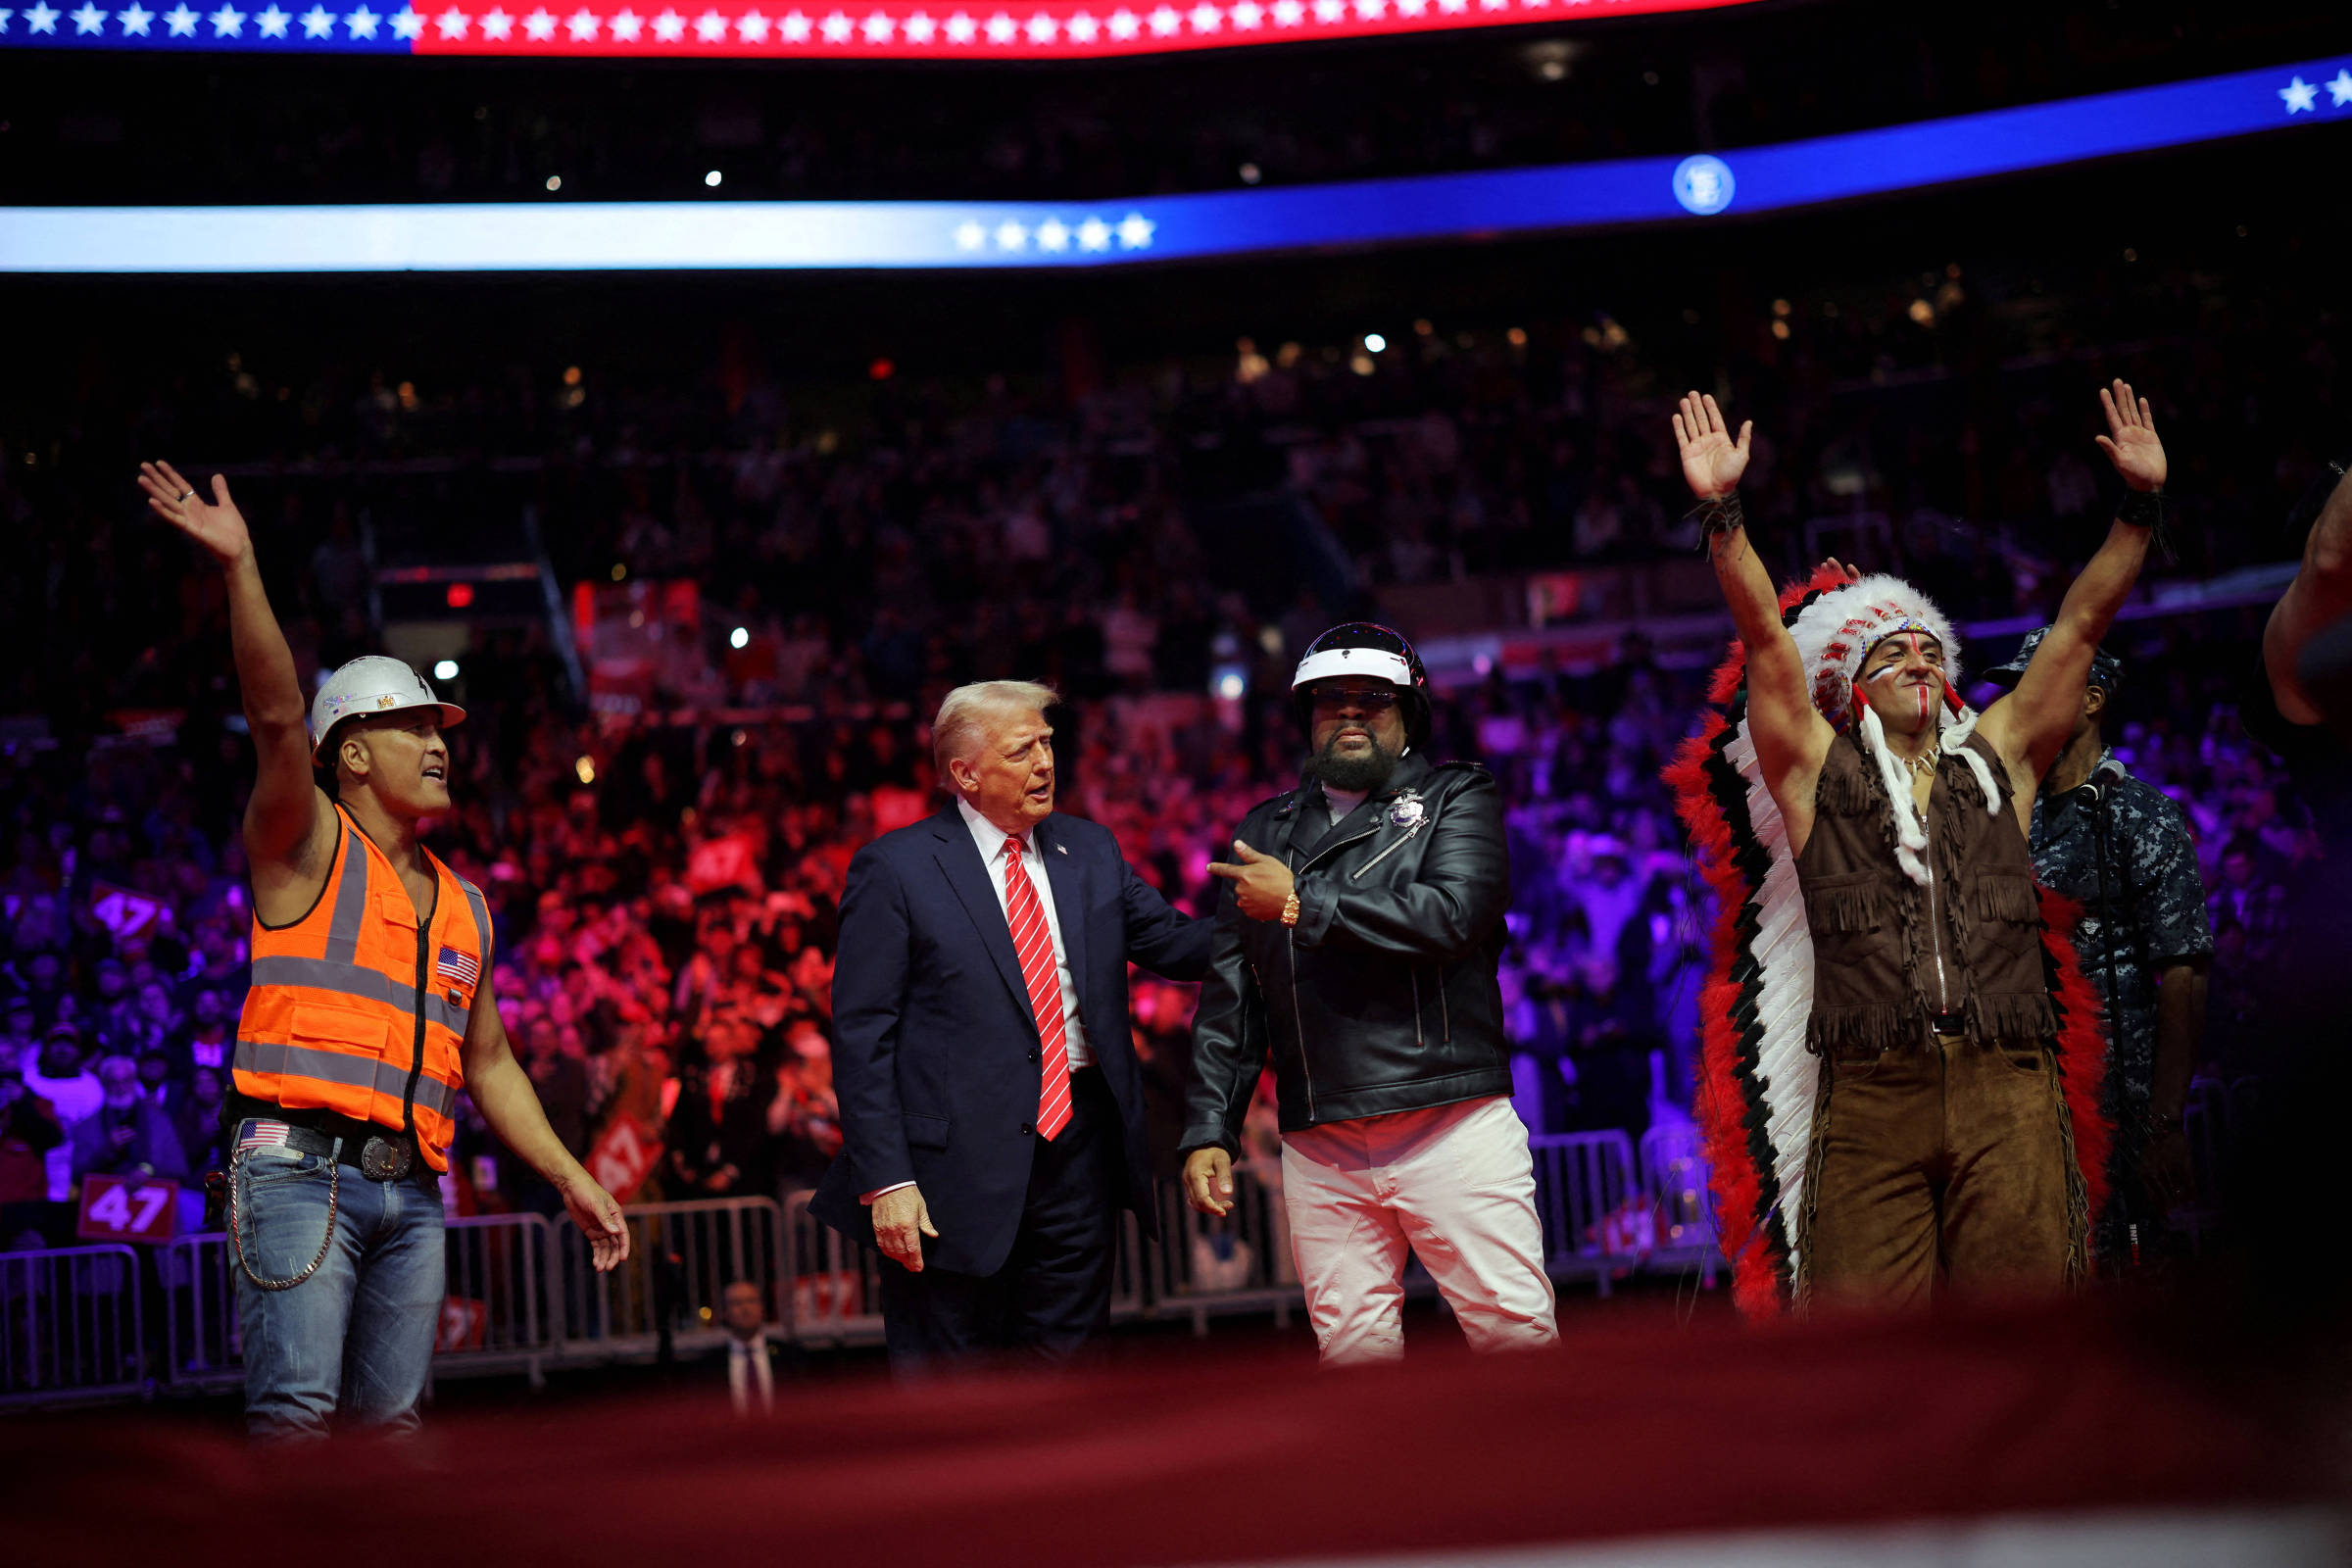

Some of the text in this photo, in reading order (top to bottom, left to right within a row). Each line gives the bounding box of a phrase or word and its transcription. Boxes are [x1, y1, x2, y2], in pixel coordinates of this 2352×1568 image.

[94, 893, 156, 936] 47
[596, 1124, 643, 1194] 47
[89, 1184, 169, 1233] 47
